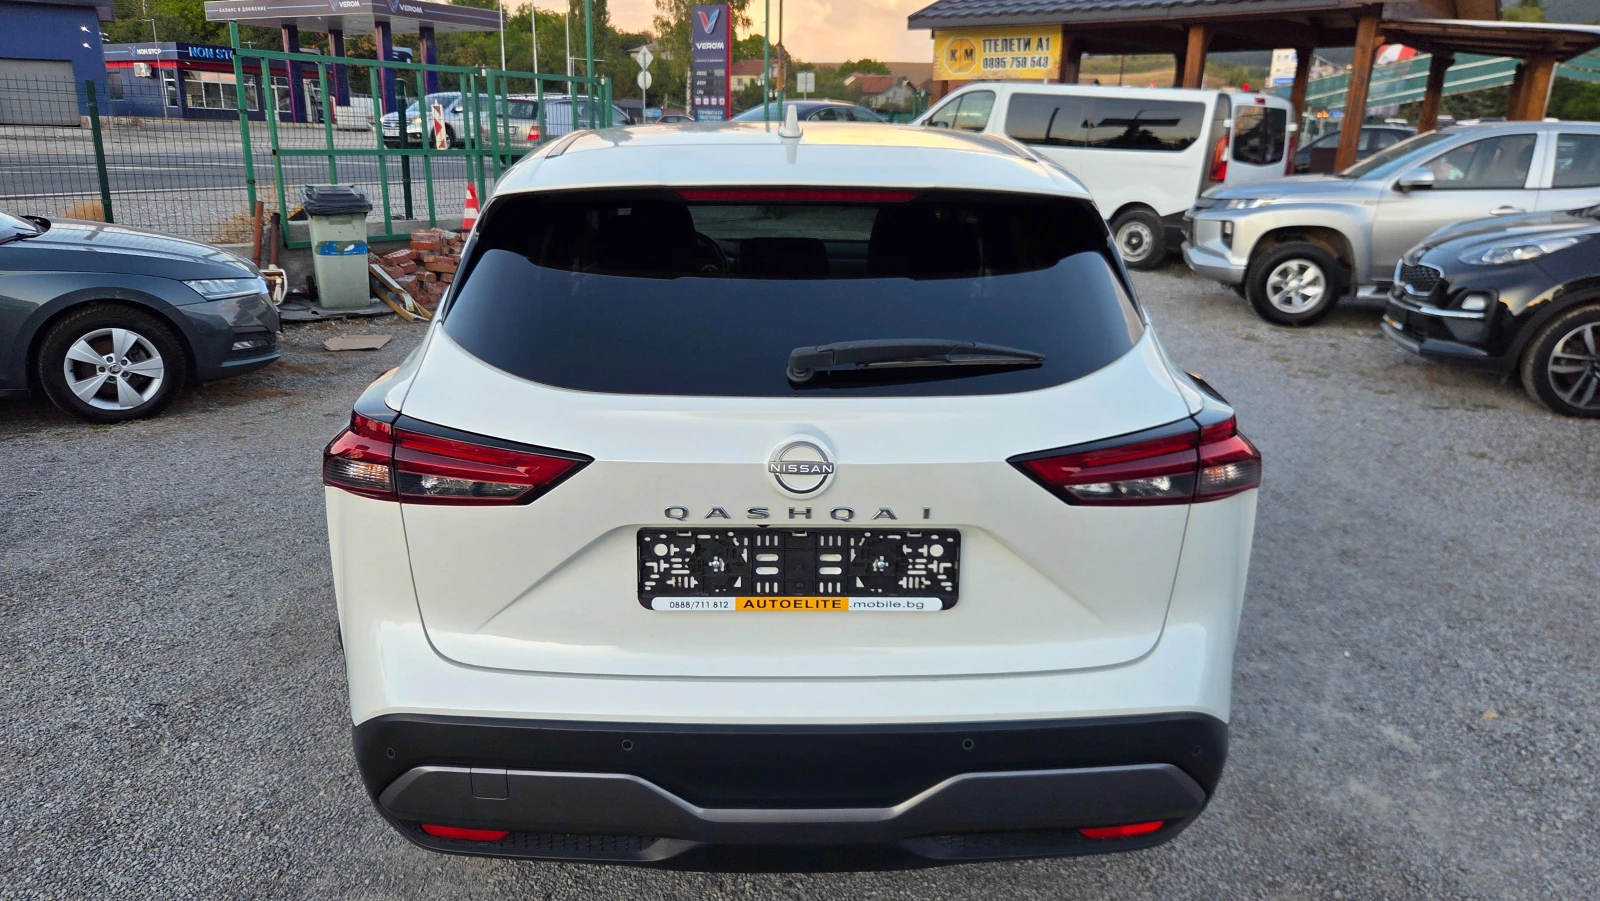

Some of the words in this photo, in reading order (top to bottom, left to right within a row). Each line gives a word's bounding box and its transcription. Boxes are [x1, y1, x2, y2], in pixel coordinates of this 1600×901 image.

[399, 4, 423, 14] VEROM
[695, 41, 725, 50] VEROM
[982, 37, 1032, 53] ПЕЛЕТИ
[188, 46, 215, 59] NON
[964, 48, 974, 61] M
[770, 463, 833, 473] NISSAN
[664, 505, 931, 522] QASHQAI
[669, 600, 710, 609] 0888/711
[713, 600, 729, 609] 812
[743, 599, 842, 609] AUTOELITE
[849, 600, 924, 610] .mobile.bg
